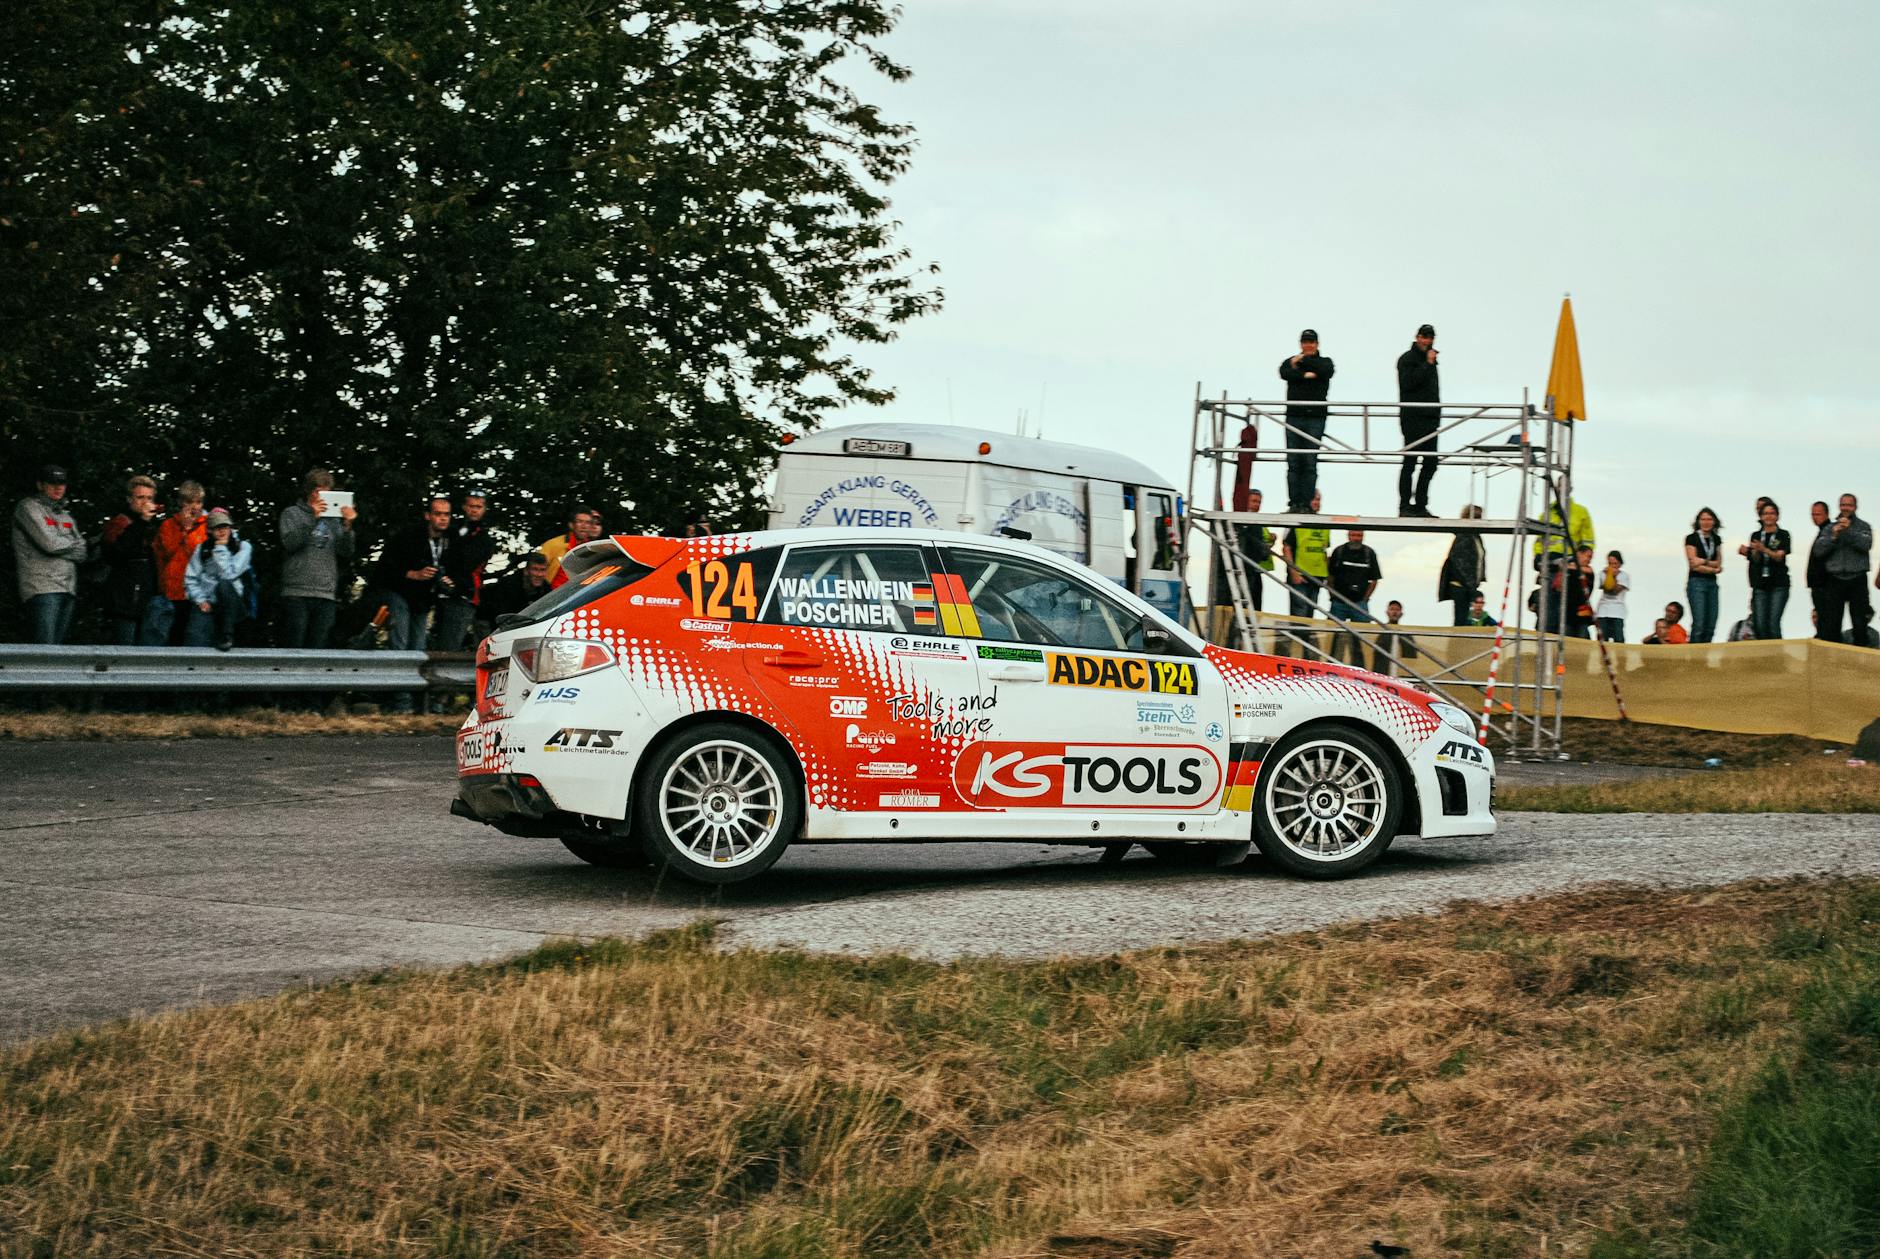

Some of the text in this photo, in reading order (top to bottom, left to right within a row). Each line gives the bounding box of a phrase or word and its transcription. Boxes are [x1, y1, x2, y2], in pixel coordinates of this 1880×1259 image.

[834, 507, 912, 528] WEBER
[687, 560, 757, 620] 124
[779, 578, 913, 600] WALLENWEIN
[645, 596, 682, 606] EHRLE
[784, 601, 895, 625] POSCHNER
[692, 620, 724, 632] Castrol
[913, 641, 960, 651] EHRLE
[789, 675, 838, 685] race:pro
[1052, 654, 1146, 690] ADAC
[1154, 661, 1194, 695] 124
[537, 687, 581, 700] HJS
[886, 684, 998, 721] Tools and
[829, 700, 868, 715] OMP
[1136, 710, 1174, 723] Stehr
[1242, 710, 1277, 718] POSCHNER
[544, 727, 624, 748] ATS
[846, 723, 896, 745] Panta
[932, 718, 994, 739] more
[464, 739, 482, 760] TOOLS
[1437, 740, 1485, 763] ATS
[970, 750, 1203, 798] KS TOOLS
[900, 788, 921, 796] AQUA
